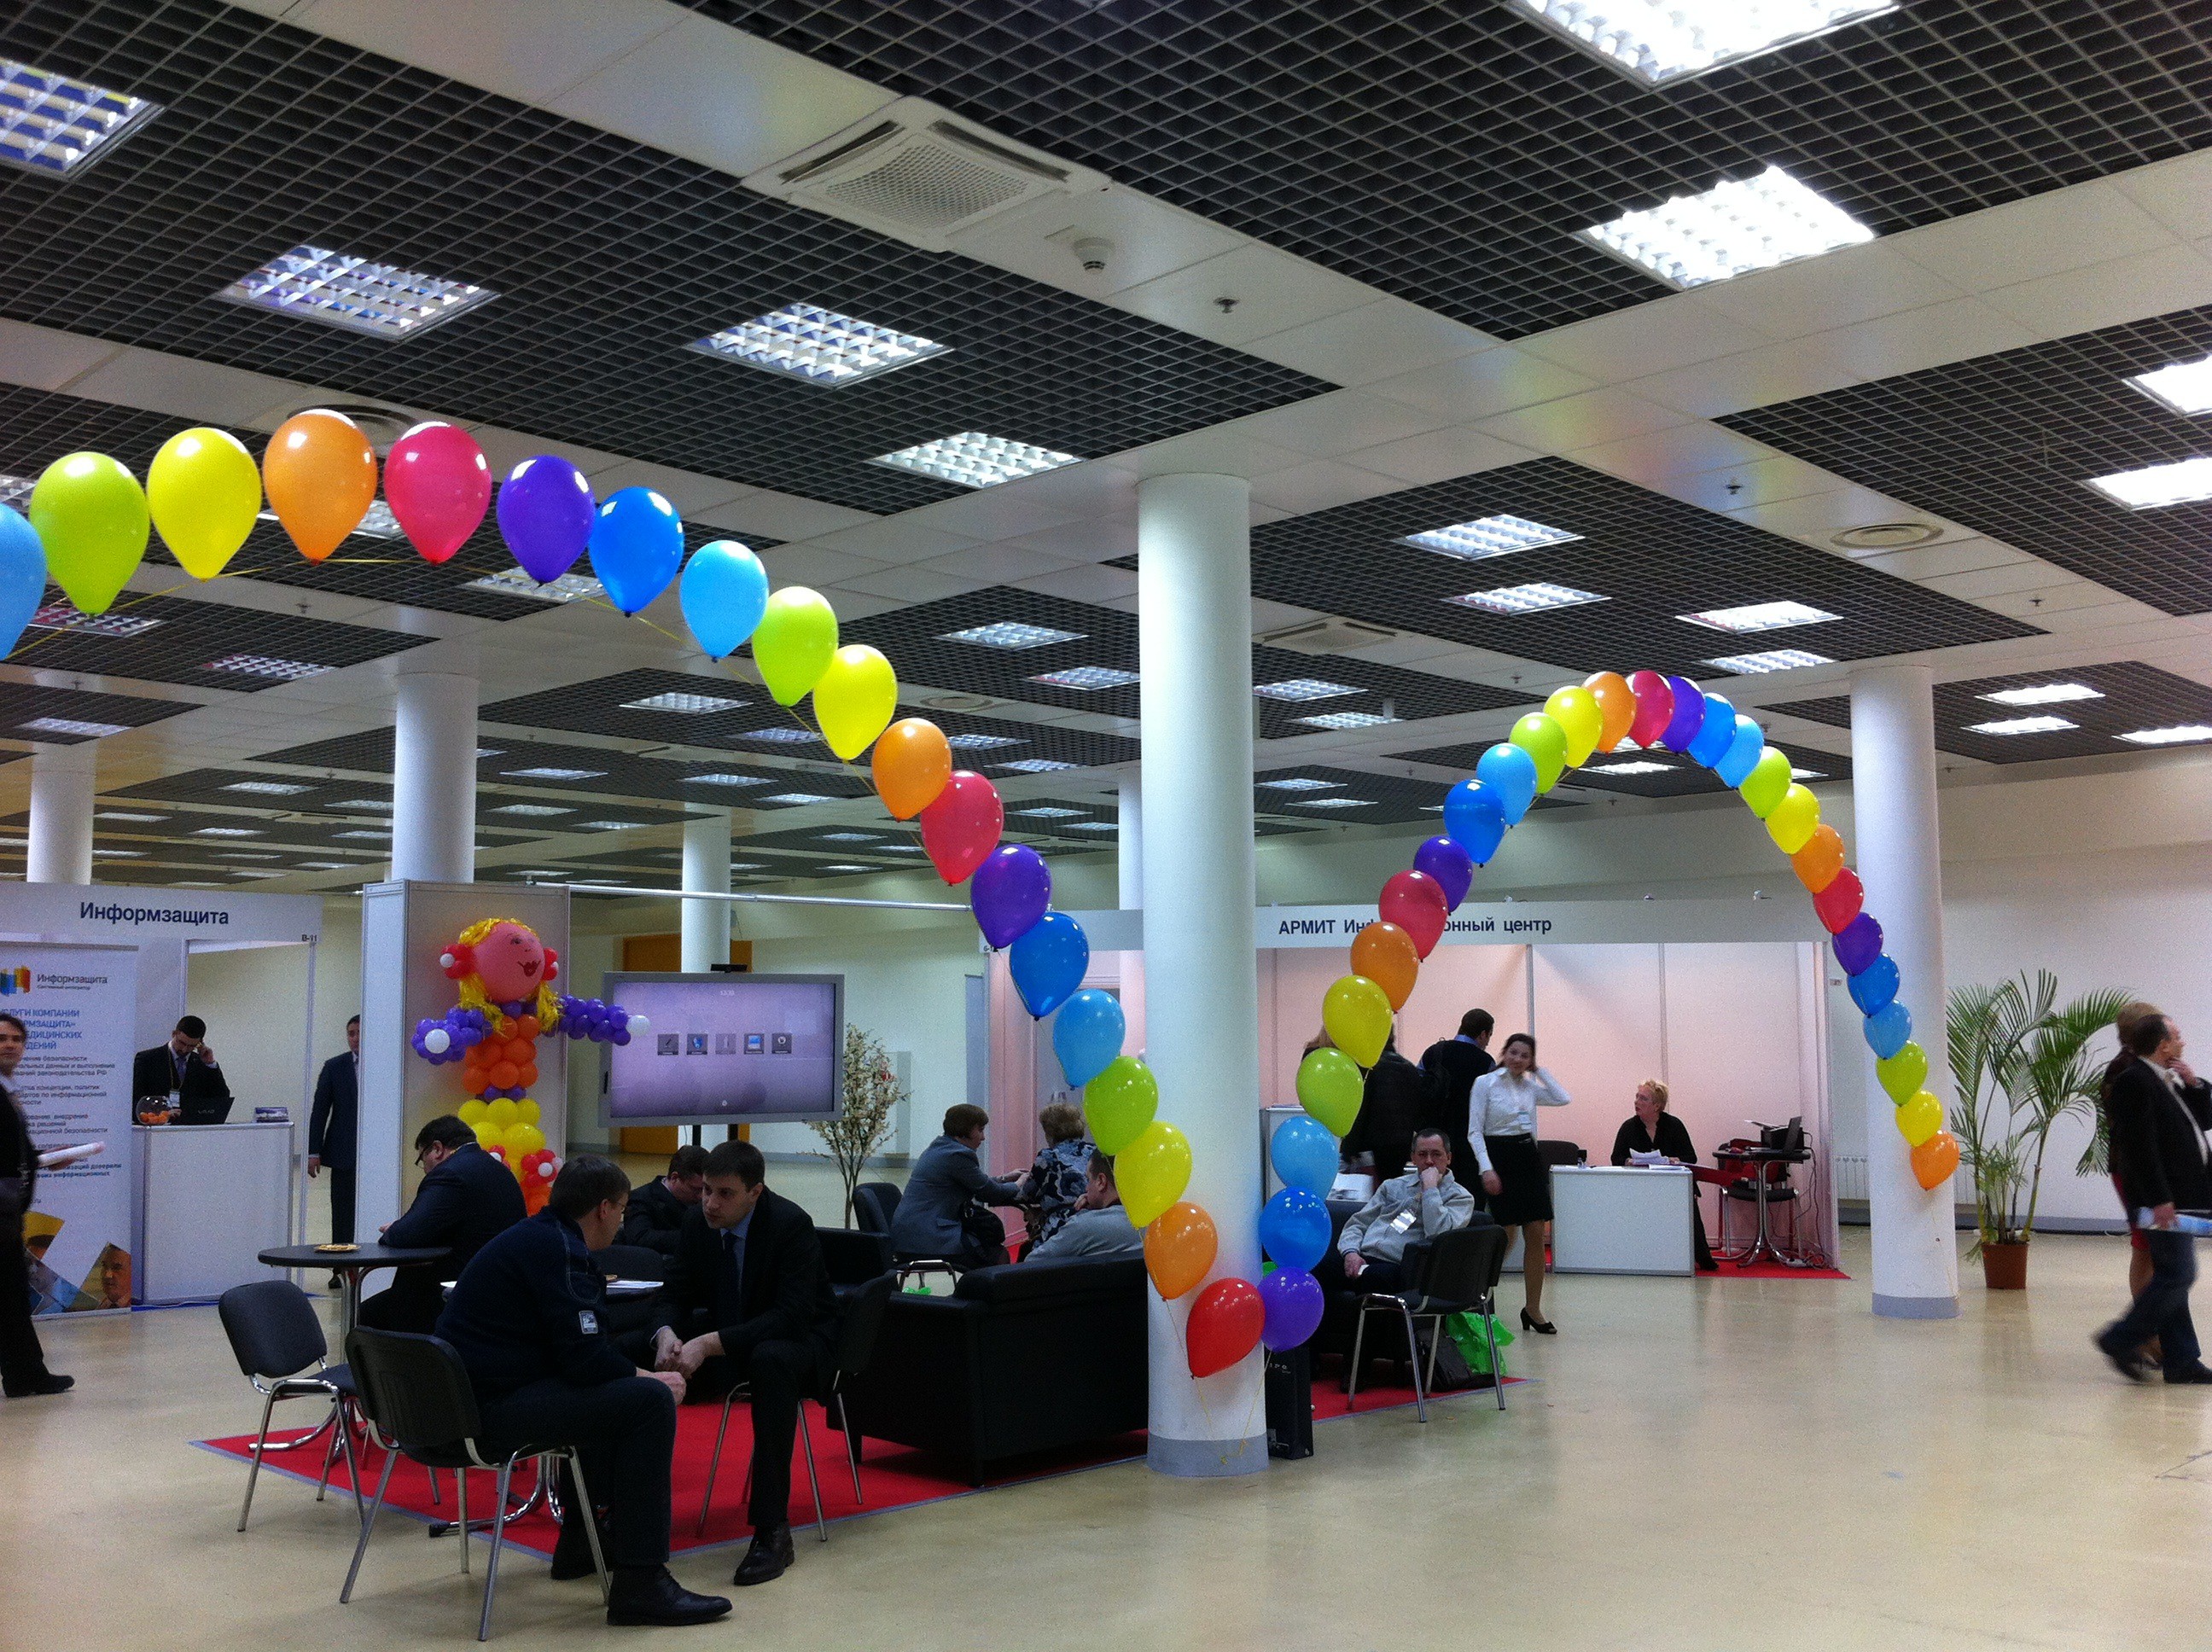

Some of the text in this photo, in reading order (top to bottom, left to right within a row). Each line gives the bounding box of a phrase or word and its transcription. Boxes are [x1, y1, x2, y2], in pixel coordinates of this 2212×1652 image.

[80, 901, 229, 926] Информзащита
[1278, 919, 1336, 934] АРМИТ
[1504, 920, 1551, 934] центр
[37, 974, 108, 985] Информзащита
[32, 1009, 79, 1017] КОМПАНИИ
